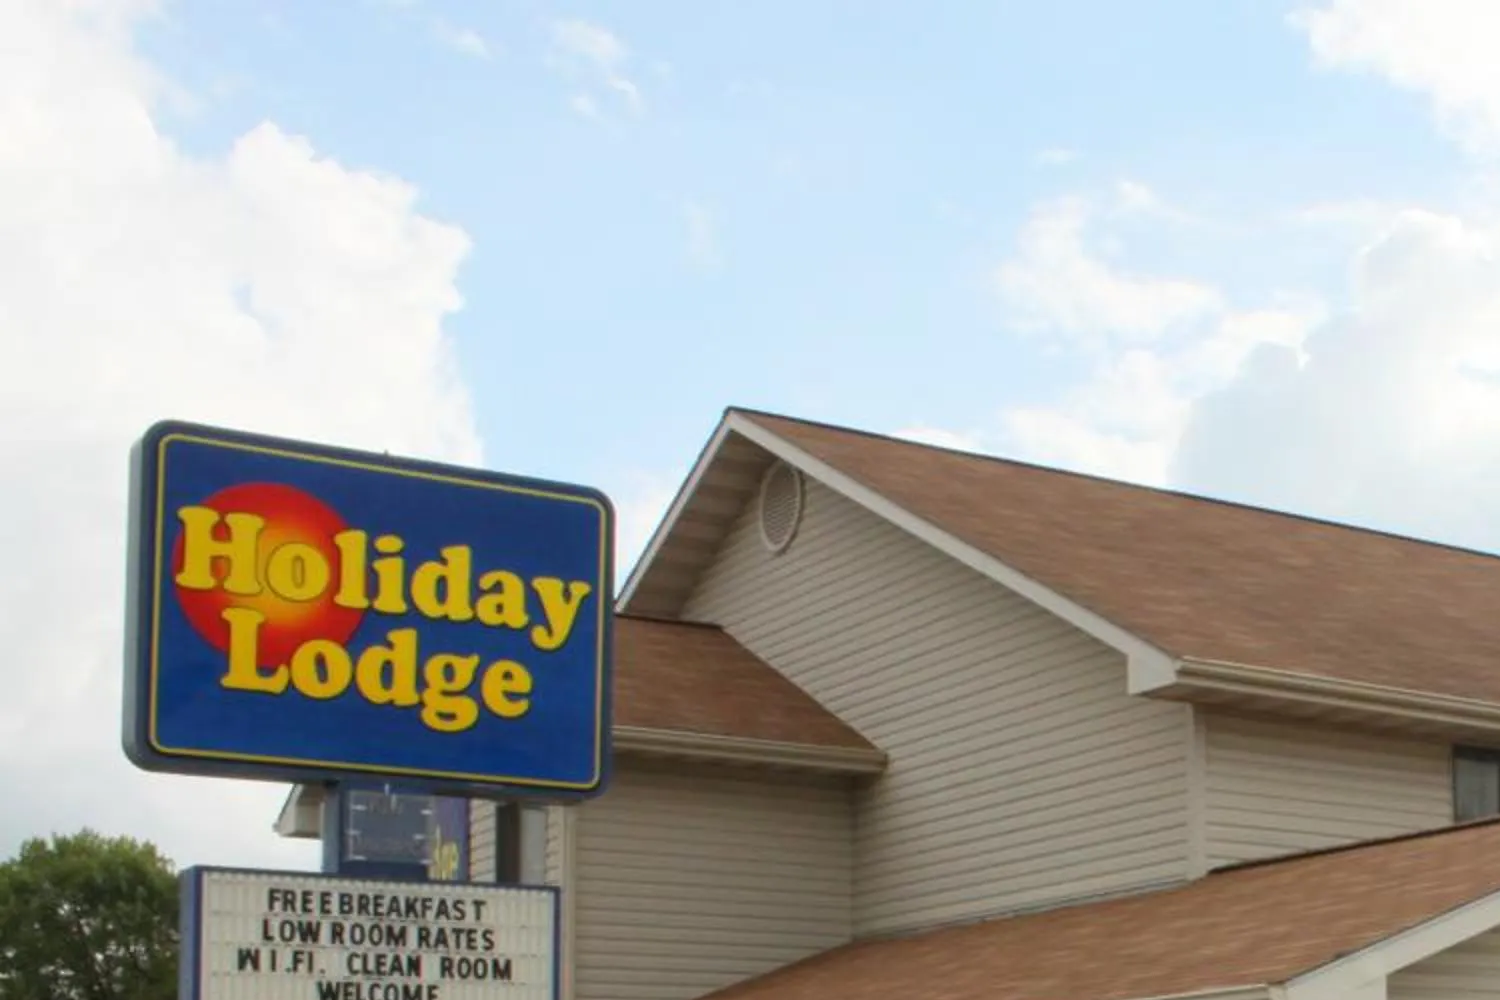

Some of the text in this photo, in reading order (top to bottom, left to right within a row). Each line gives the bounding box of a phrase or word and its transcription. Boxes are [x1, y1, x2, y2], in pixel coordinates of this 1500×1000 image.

[175, 505, 592, 650] Holiday
[220, 606, 534, 732] Lodge
[262, 918, 496, 952] LOW ROOM RATES
[346, 952, 423, 978] CLEAN
[439, 955, 513, 982] ROOM
